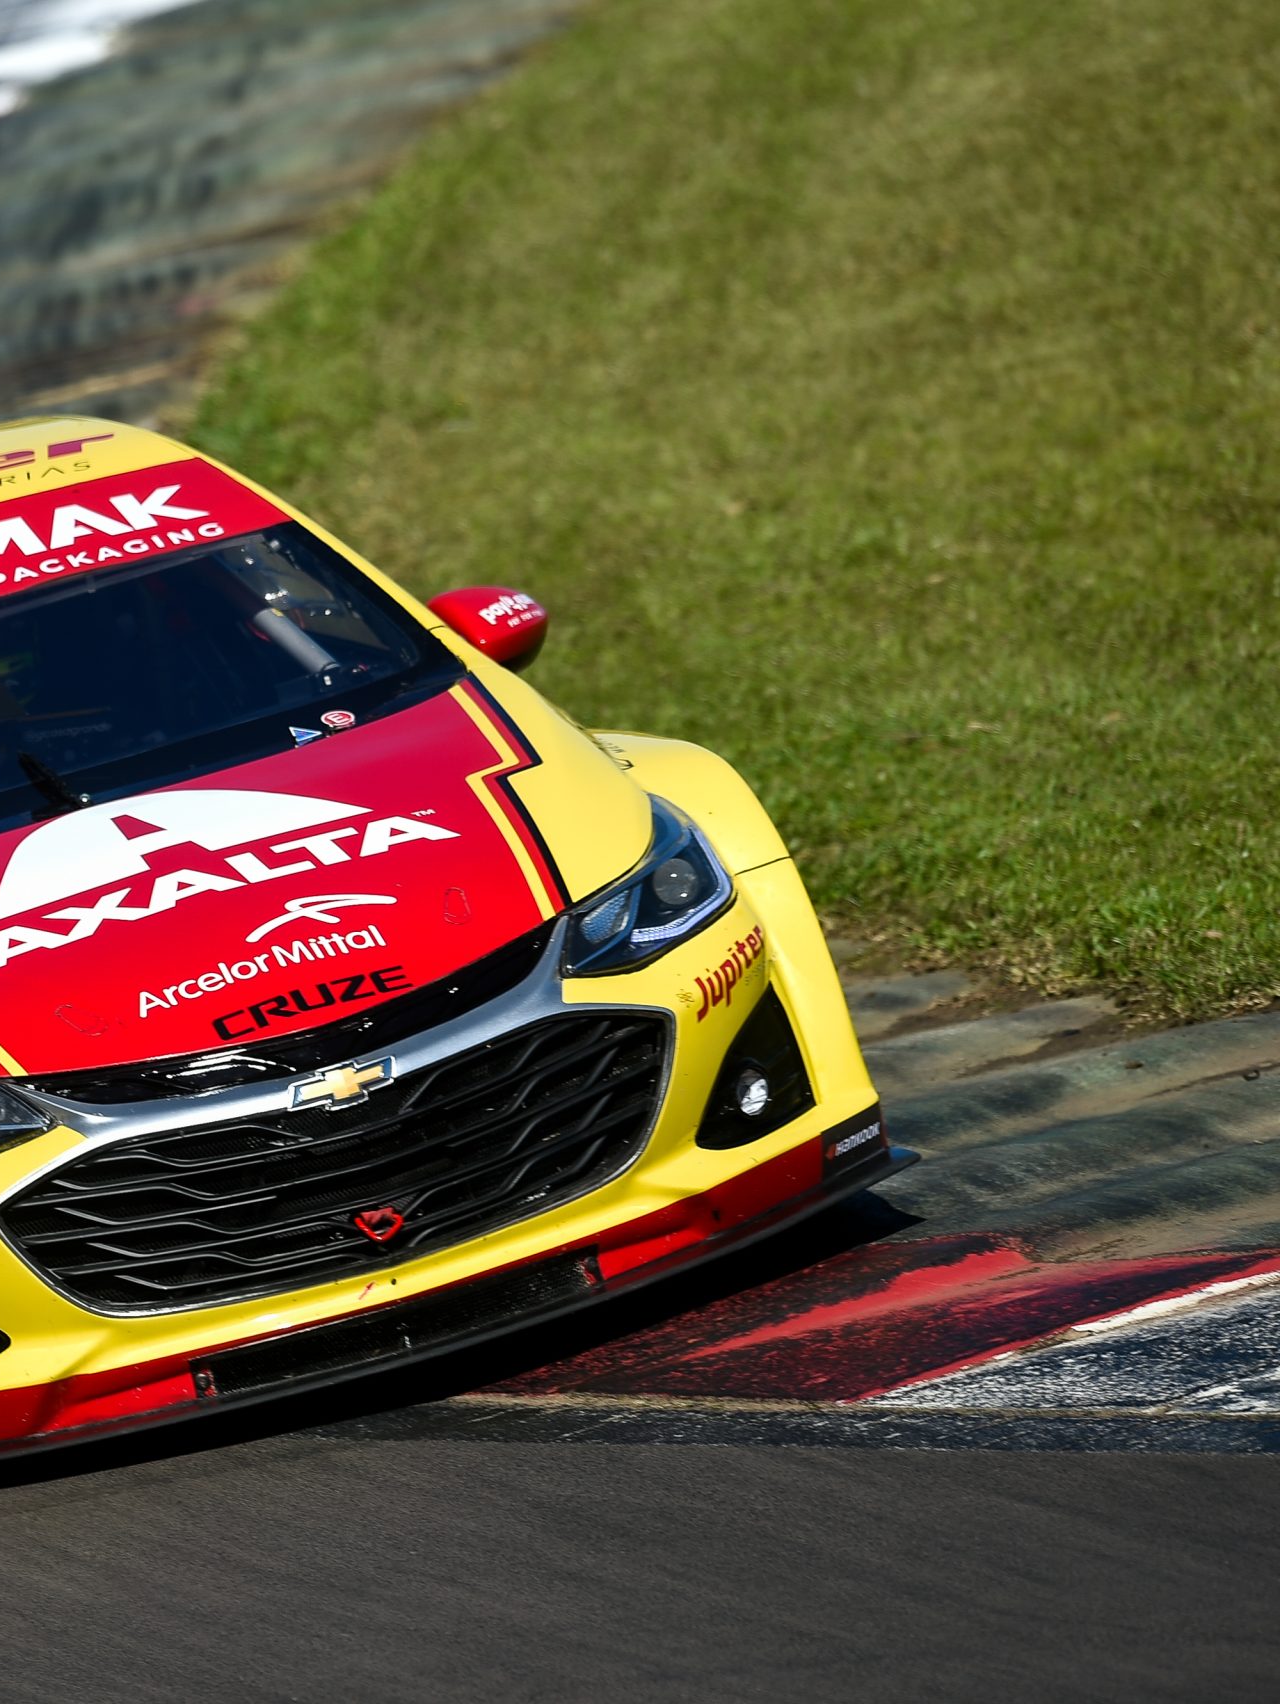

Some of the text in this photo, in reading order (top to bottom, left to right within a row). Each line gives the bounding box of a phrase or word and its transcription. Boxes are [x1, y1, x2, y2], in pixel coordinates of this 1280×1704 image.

[138, 924, 387, 1018] ArcelorMittal
[211, 965, 415, 1041] CRUZE
[694, 925, 763, 1023] Júpiter
